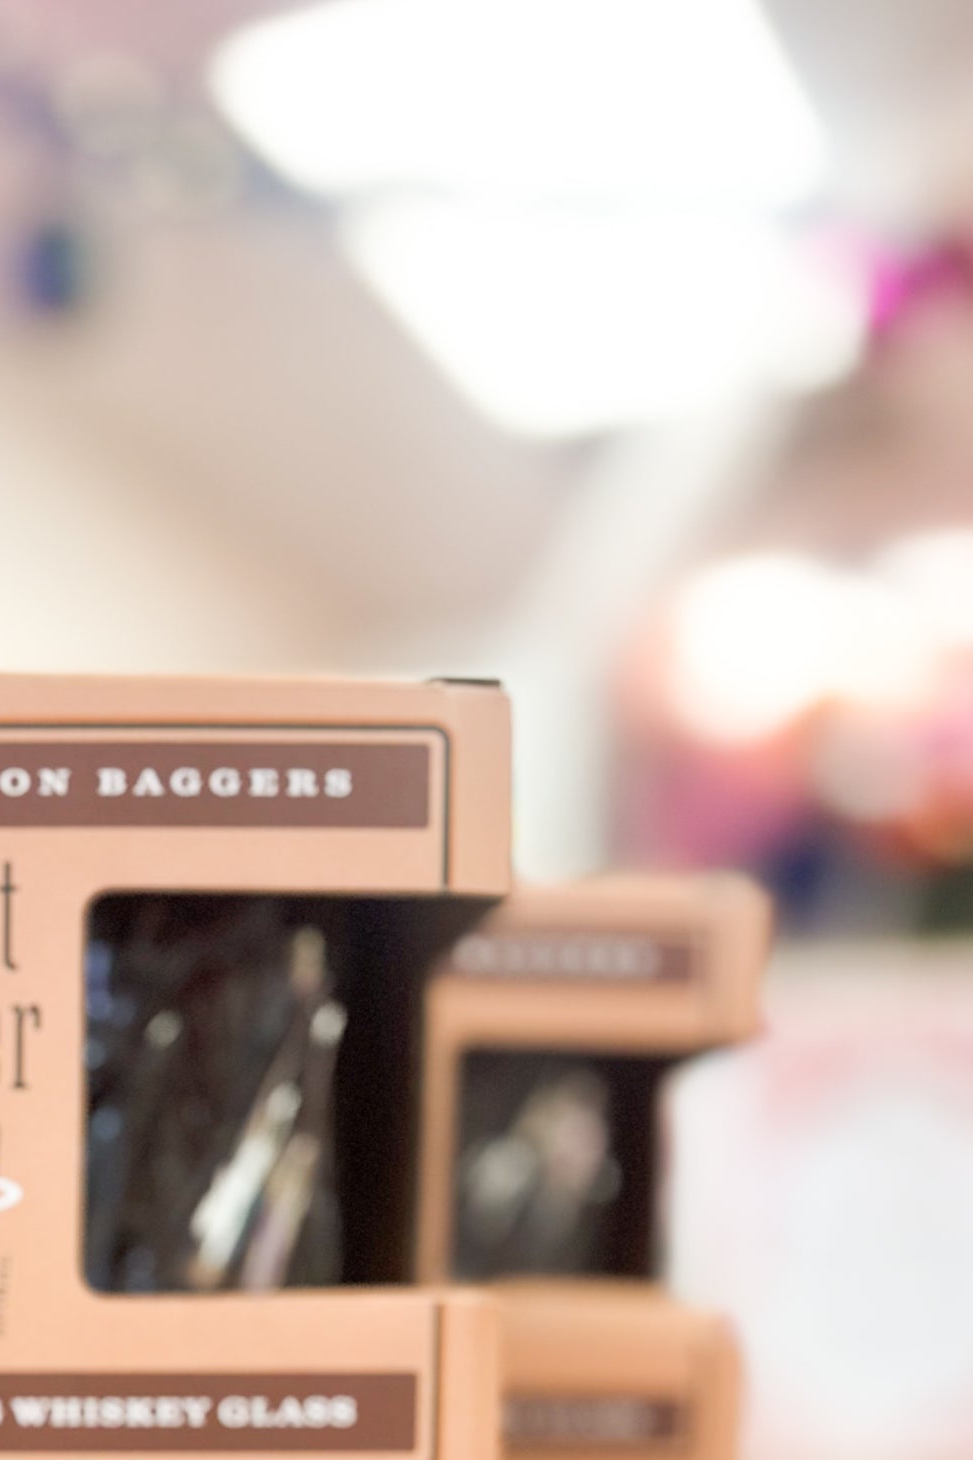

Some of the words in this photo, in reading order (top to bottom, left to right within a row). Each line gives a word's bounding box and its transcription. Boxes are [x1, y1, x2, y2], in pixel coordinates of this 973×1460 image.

[97, 768, 354, 799] BAGGERS
[12, 1395, 206, 1429] WHISKEY
[217, 1395, 357, 1429] GLASS
